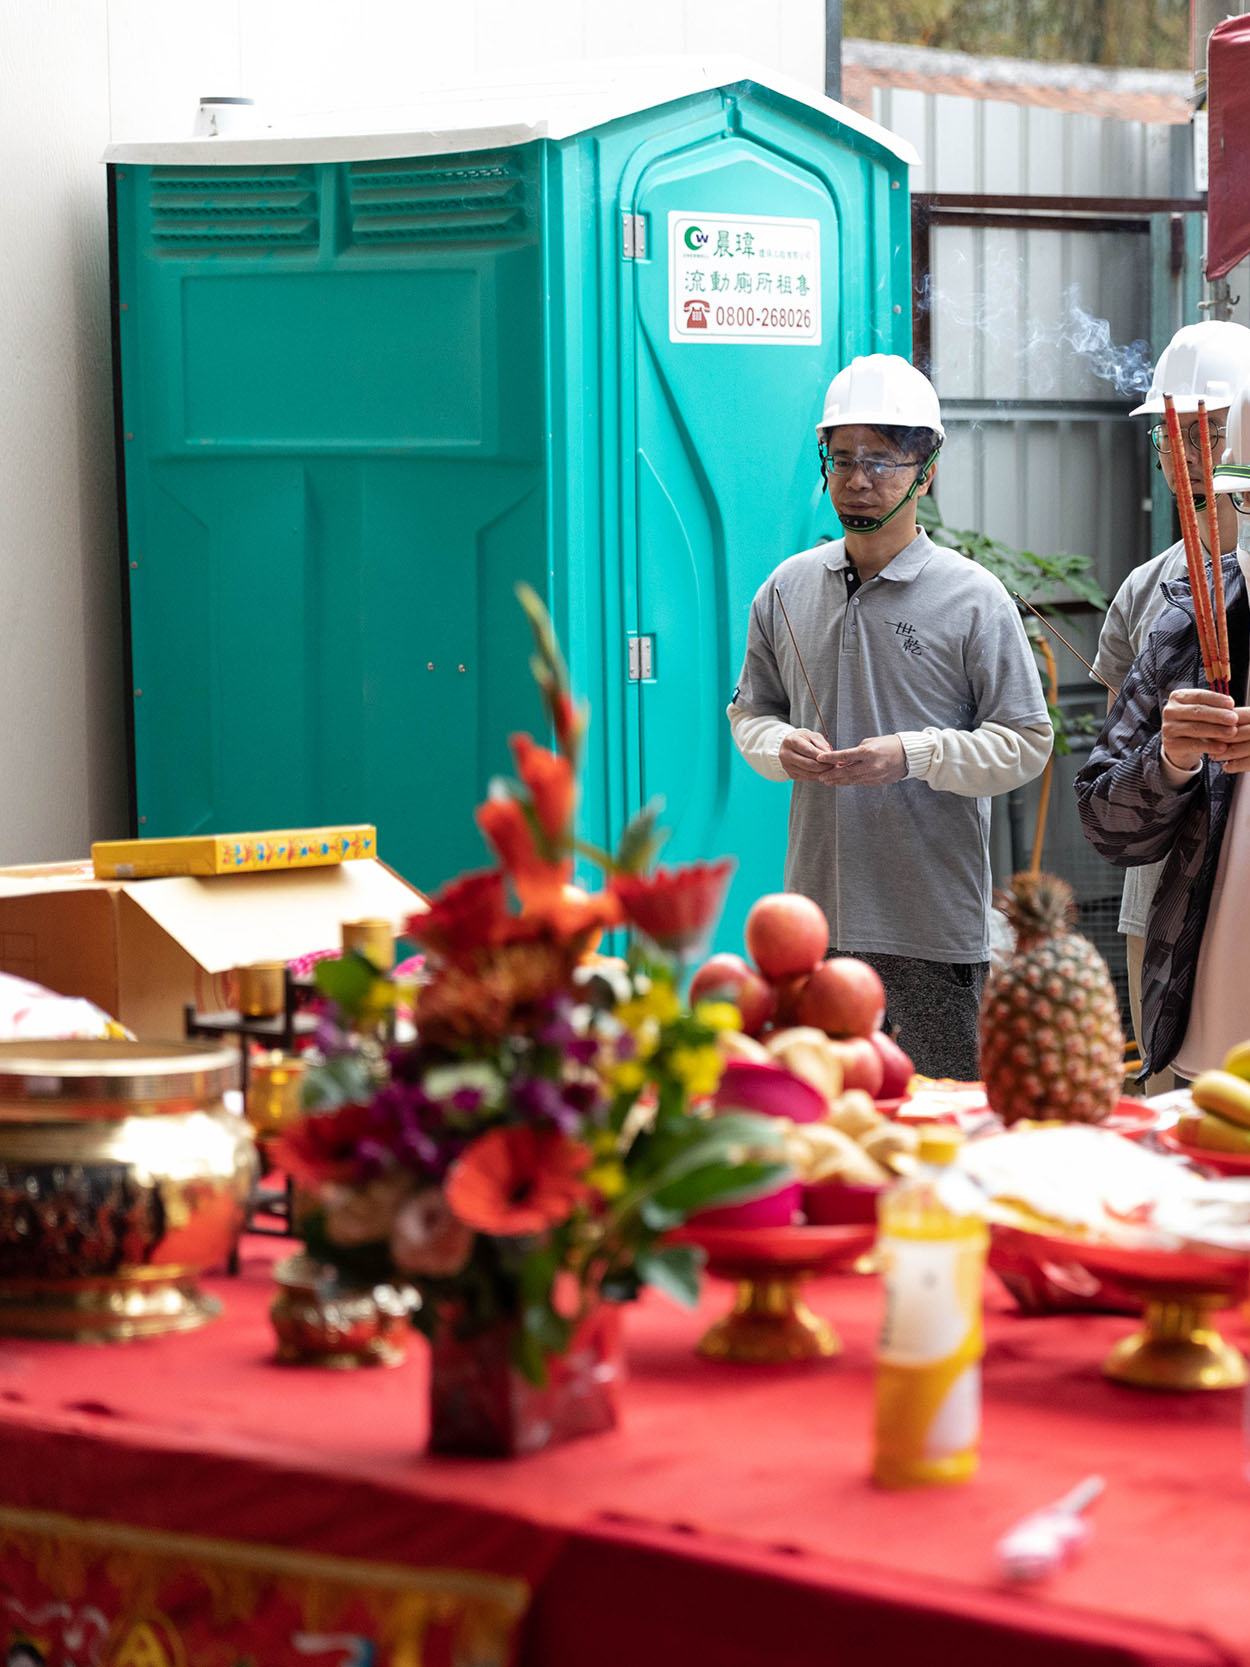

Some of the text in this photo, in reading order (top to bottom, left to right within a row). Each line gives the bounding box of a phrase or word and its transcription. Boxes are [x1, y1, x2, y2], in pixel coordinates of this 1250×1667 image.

[713, 230, 755, 259] 晨瑋
[685, 269, 810, 297] 流動廁所租售
[716, 306, 811, 329] 0800-268026
